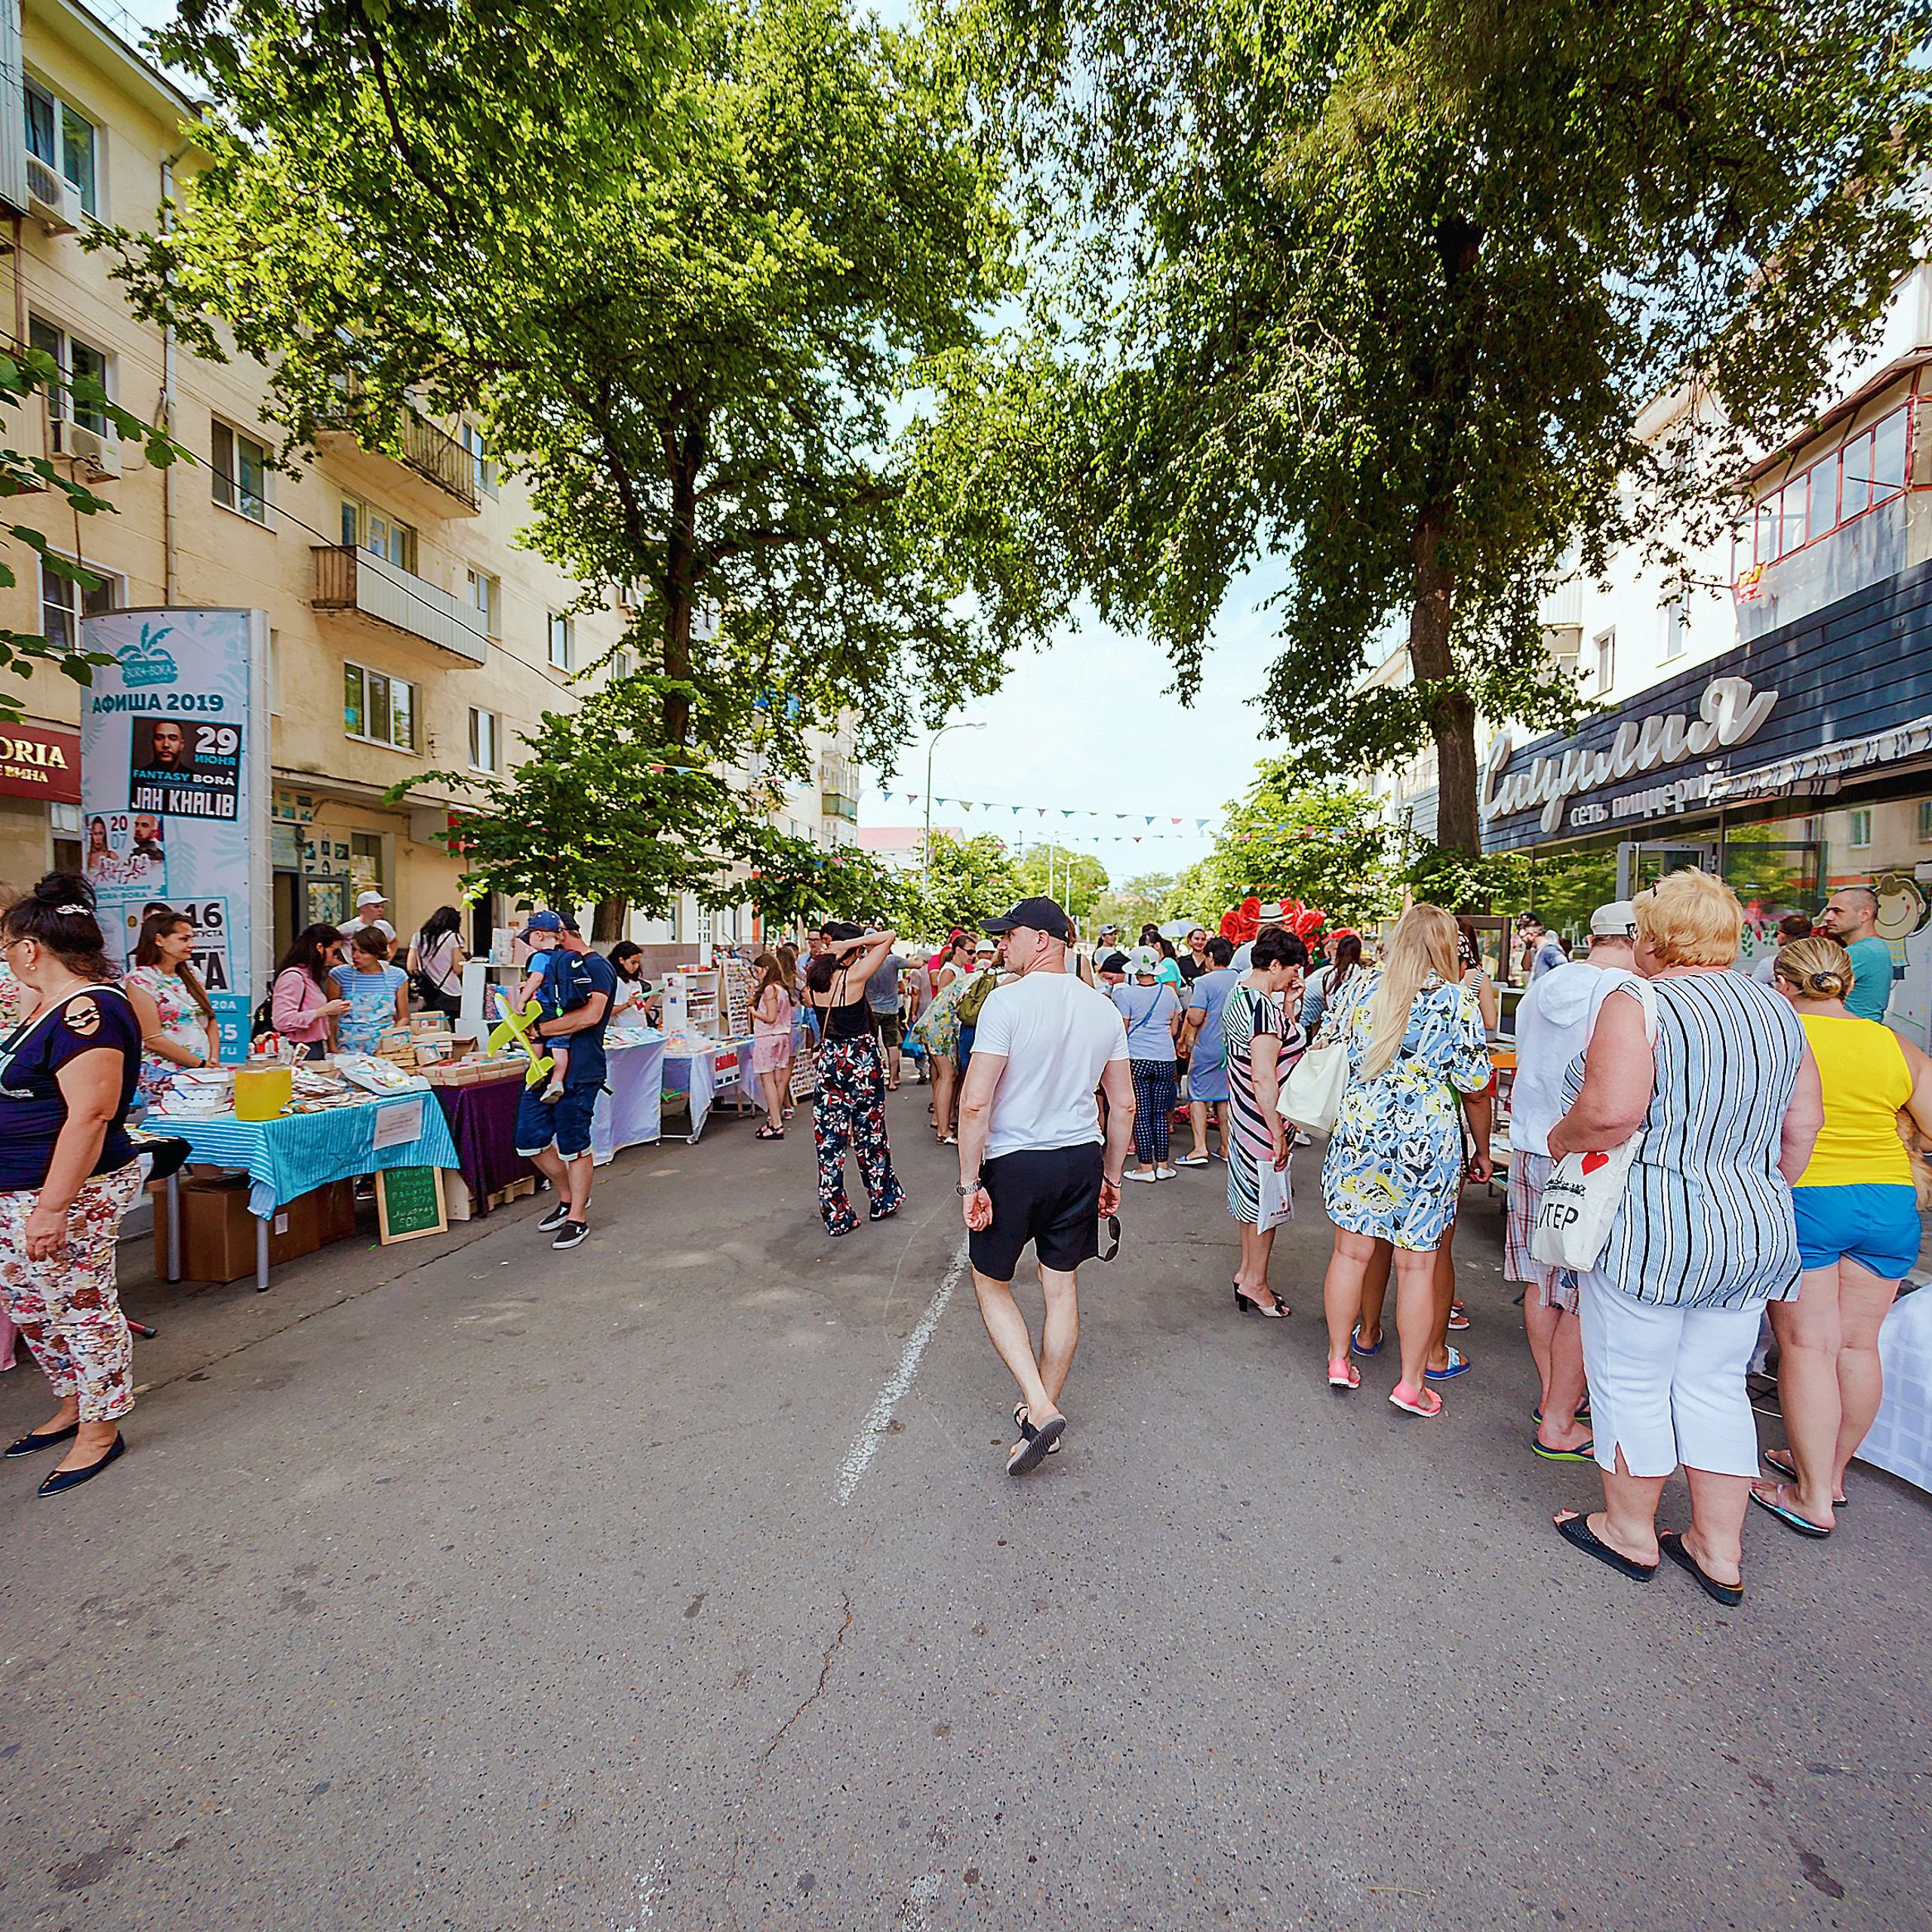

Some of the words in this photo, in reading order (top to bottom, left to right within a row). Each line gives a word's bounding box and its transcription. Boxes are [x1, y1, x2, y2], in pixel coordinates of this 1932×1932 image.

[92, 693, 162, 713] АФИША
[166, 693, 224, 712] 2019
[195, 726, 238, 755] 29
[194, 754, 236, 766] ИЮНЯ
[133, 770, 190, 782] FANTASY
[192, 774, 235, 786] BORA
[131, 787, 163, 811] JAH
[168, 789, 235, 817] KHALIB
[110, 815, 128, 832] 20
[1571, 804, 1609, 827] сеть
[110, 833, 128, 849] 07
[184, 903, 223, 929] 16
[190, 952, 228, 989] ТА
